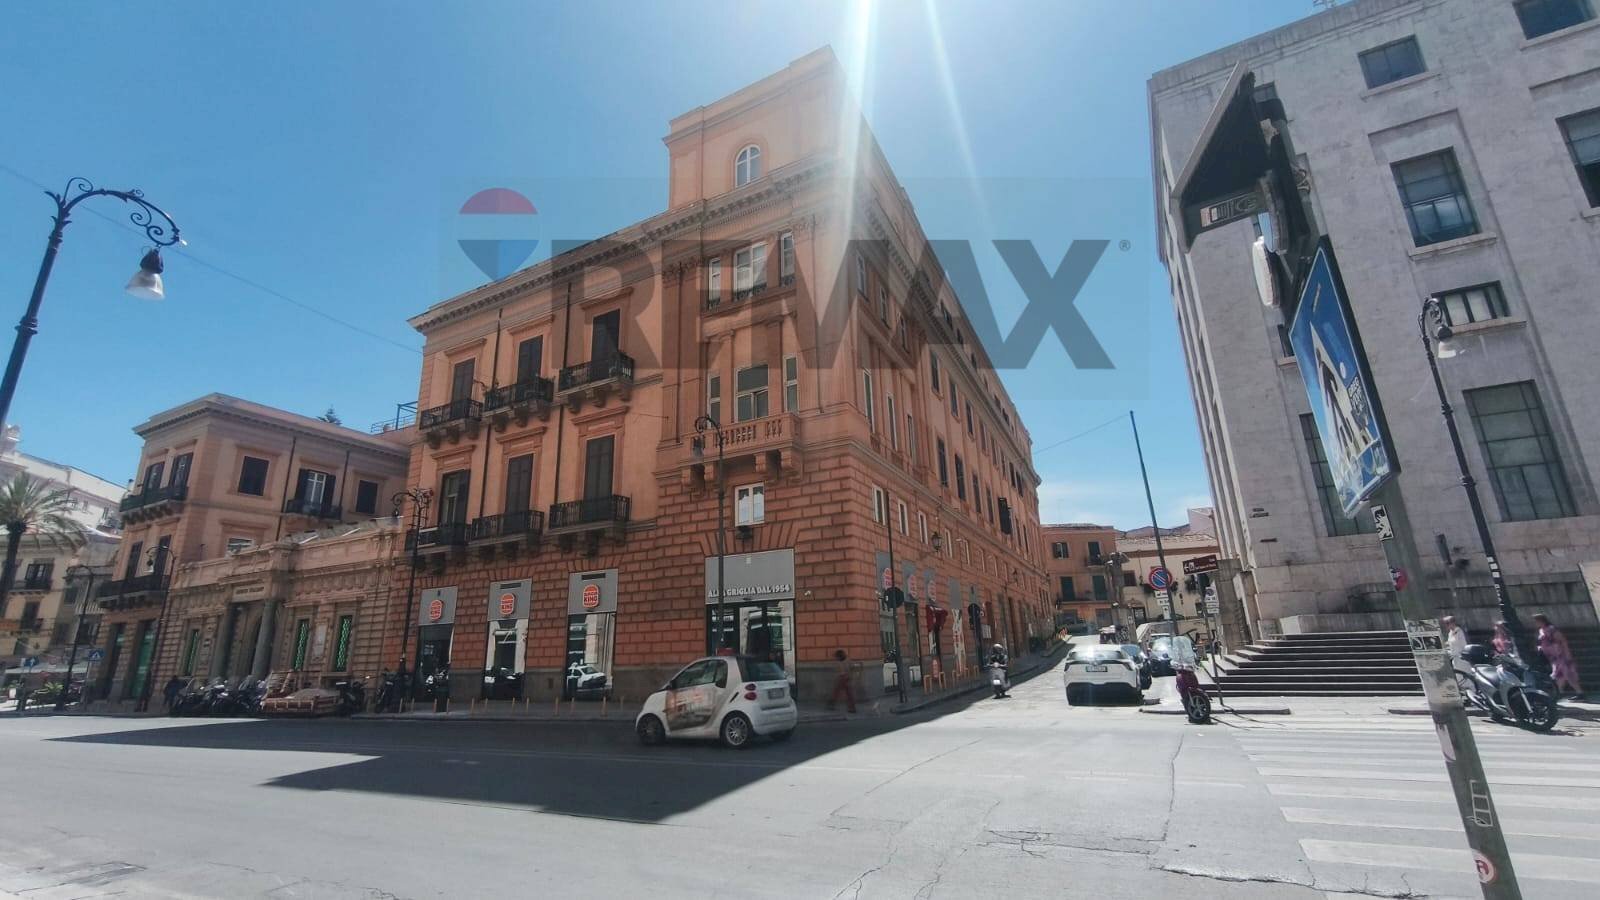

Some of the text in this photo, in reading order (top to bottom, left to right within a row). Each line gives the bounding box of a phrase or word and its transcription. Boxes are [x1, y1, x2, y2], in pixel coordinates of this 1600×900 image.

[707, 584, 790, 598] ALL GRIGLIA DAL 1954
